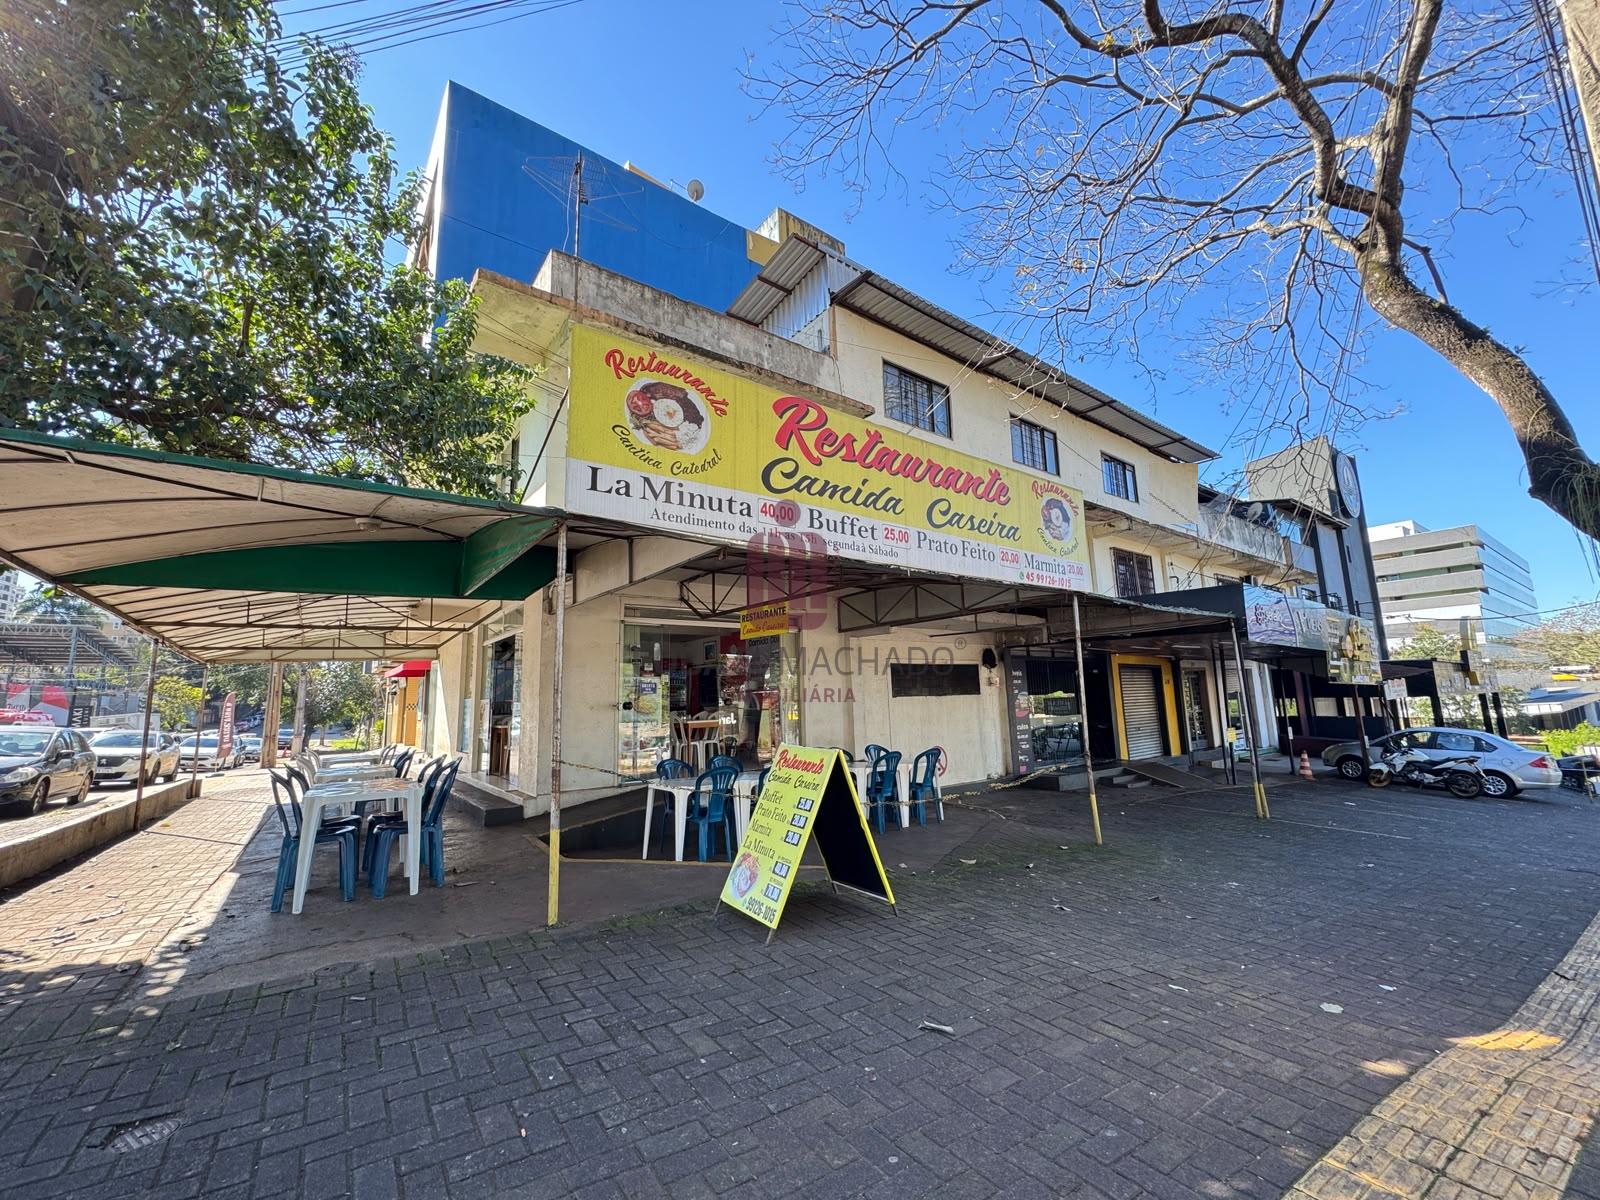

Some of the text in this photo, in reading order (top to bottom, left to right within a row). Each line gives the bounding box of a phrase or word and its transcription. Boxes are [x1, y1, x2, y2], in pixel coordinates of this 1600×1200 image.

[604, 348, 730, 418] Restaurante
[611, 424, 722, 476] Cantina Catedral
[772, 395, 1012, 506] Restaurante
[586, 464, 633, 498] La
[640, 475, 753, 518] Minuta
[760, 502, 794, 522] 40,00
[807, 508, 878, 541] Buffet
[884, 527, 909, 543] 25,00
[916, 530, 958, 556] Prato
[961, 540, 996, 563] Feito
[1000, 550, 1019, 564] 20,00
[1024, 552, 1067, 576] Marmita
[650, 508, 735, 531] Atendimento
[738, 522, 758, 534] das
[868, 544, 899, 558] Sábado
[926, 497, 1022, 543] Caseira
[1025, 571, 1035, 583] 45
[742, 606, 787, 623] RESTAURANTE
[775, 748, 825, 775] Restaurante
[762, 787, 783, 805] Buffet
[794, 775, 821, 791] Caseira
[756, 802, 772, 819] Prato
[771, 806, 787, 823] Feito
[743, 835, 752, 850] La
[751, 839, 776, 860] Minuta
